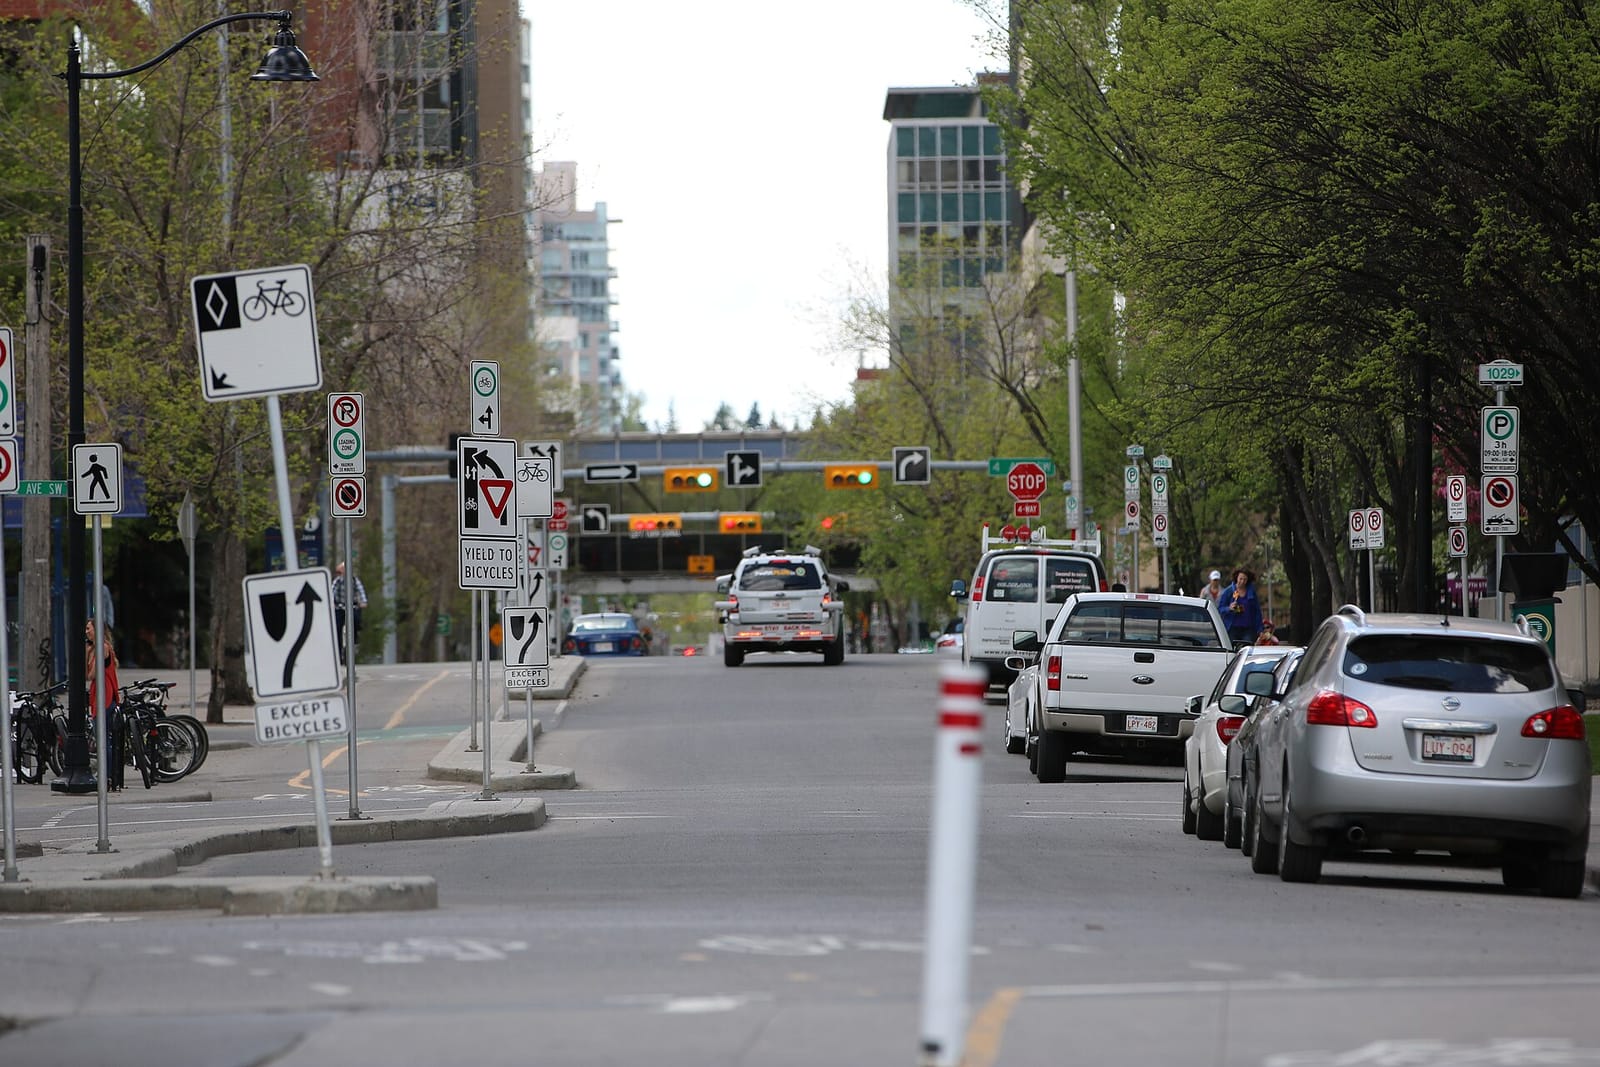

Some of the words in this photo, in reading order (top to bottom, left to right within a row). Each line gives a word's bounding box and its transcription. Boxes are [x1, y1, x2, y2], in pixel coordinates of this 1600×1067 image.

[1487, 367, 1515, 380] 1029
[26, 482, 42, 495] AVE
[49, 482, 63, 495] SW
[1009, 475, 1044, 491] STOP
[1017, 505, 1037, 513] 4-WAY
[464, 547, 494, 560] YIELD
[499, 549, 512, 561] TO
[464, 565, 514, 580] BICYCLES
[511, 670, 542, 678] EXCEPT
[507, 678, 546, 687] BICYCLES
[270, 701, 329, 720] EXCEPT
[264, 717, 341, 739] BICYCLES
